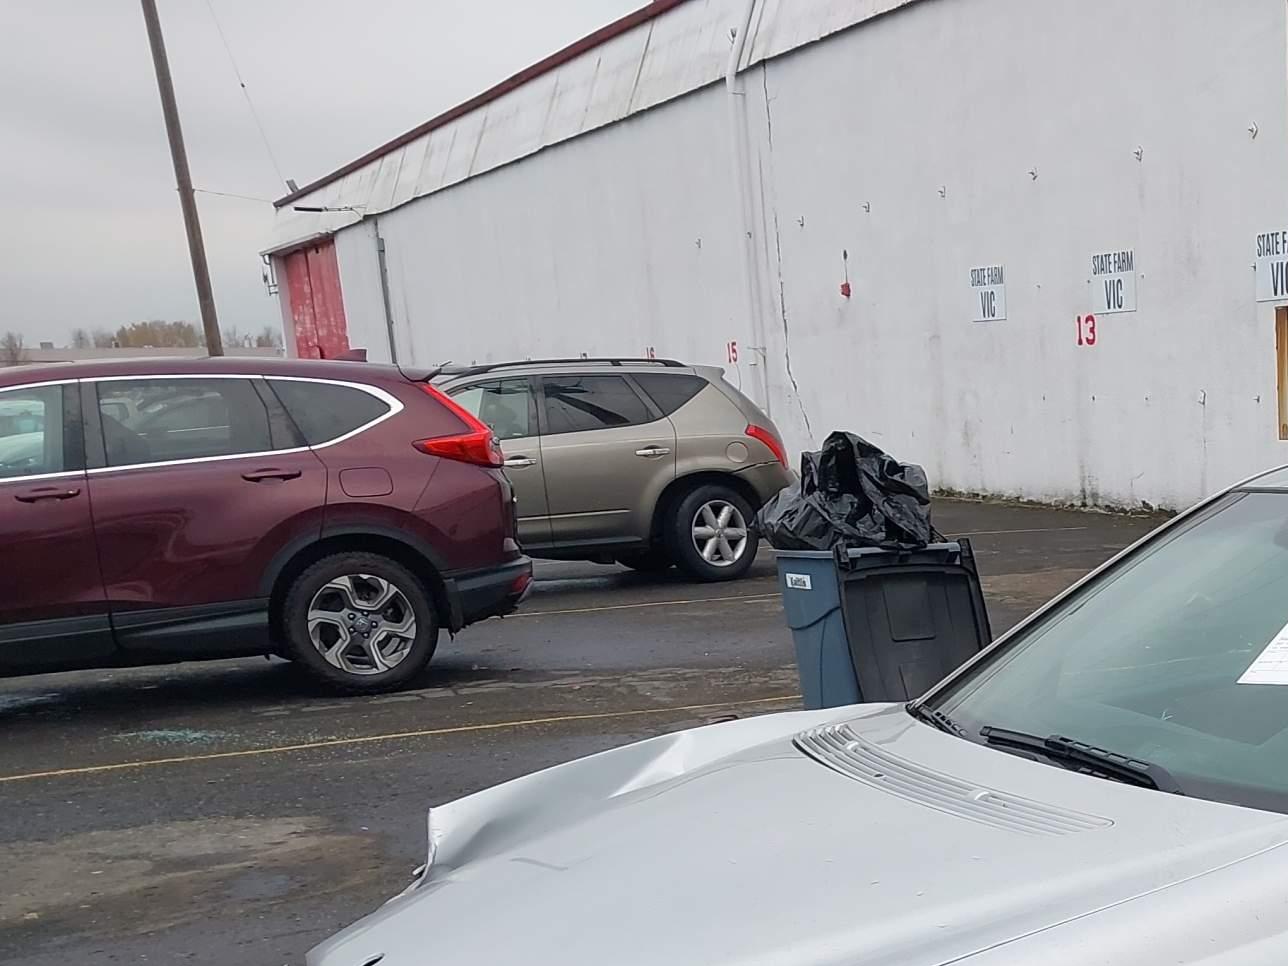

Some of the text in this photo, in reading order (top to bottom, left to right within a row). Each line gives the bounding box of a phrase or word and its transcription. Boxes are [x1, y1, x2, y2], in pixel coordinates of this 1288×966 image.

[1256, 231, 1280, 257] STATE
[970, 265, 1004, 287] STATE FARM
[1092, 250, 1134, 276] STATE FARM
[980, 290, 996, 318] VIC
[1104, 278, 1123, 310] VIC
[1076, 314, 1096, 346] 13
[727, 341, 738, 364] 15
